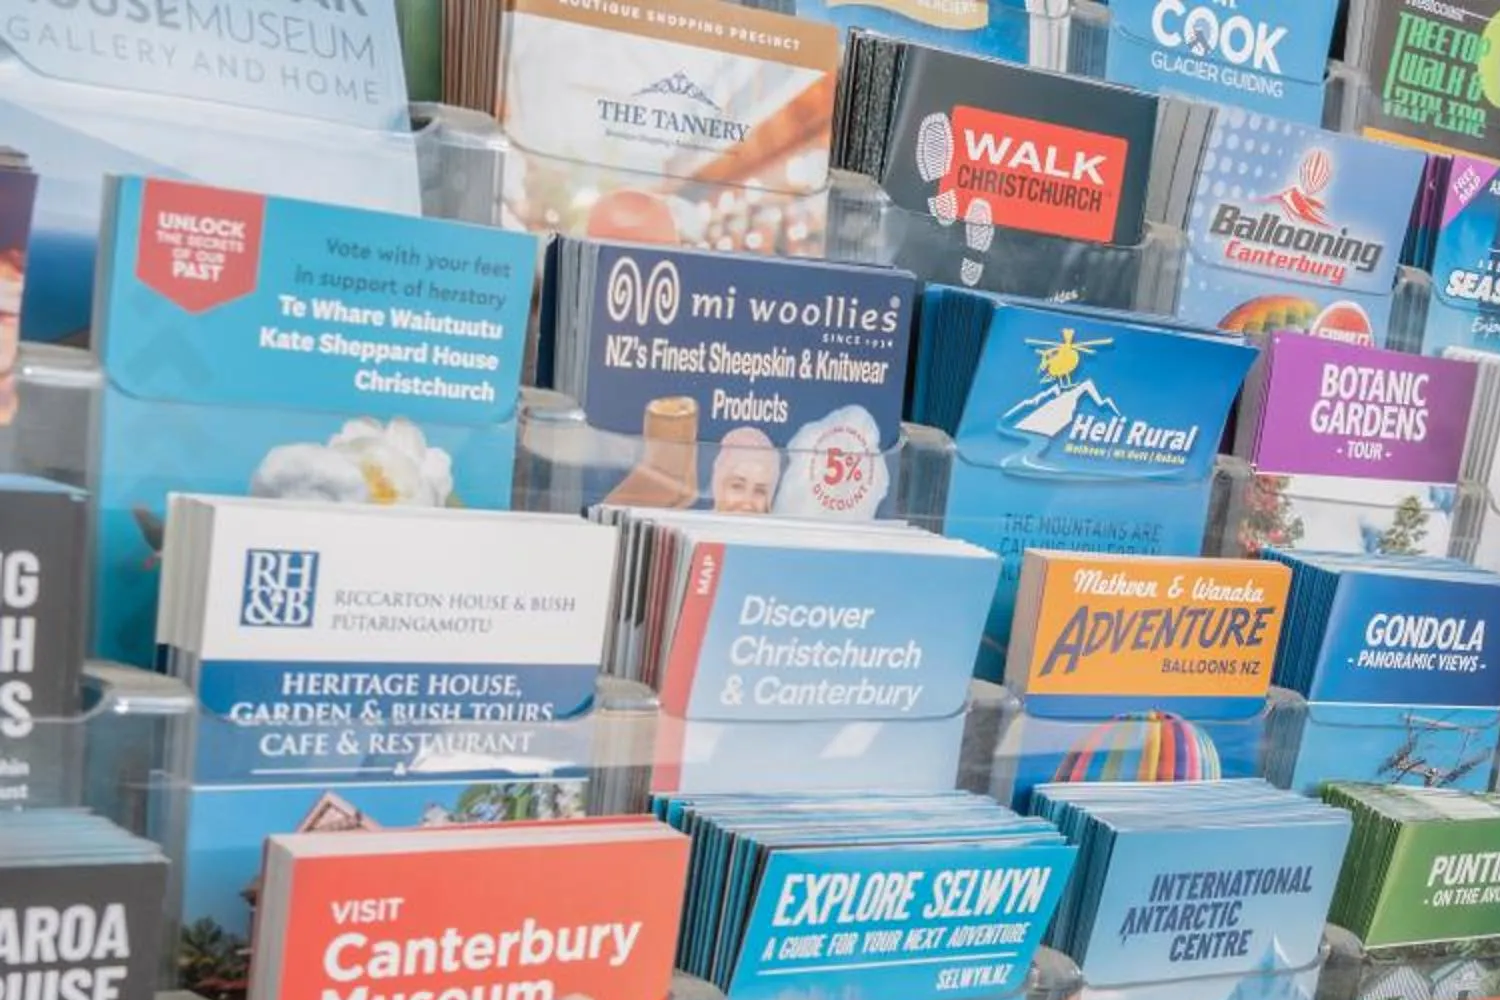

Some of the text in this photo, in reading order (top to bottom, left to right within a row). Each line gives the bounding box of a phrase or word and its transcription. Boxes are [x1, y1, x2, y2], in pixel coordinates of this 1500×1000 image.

[1152, 0, 1288, 74] COOK
[1152, 51, 1283, 97] GLACIER GUIDING
[597, 100, 646, 126] THE
[651, 109, 750, 143] TANNERY
[963, 127, 1107, 186] WALK
[956, 164, 1103, 212] CHRISTCHURCH
[158, 211, 246, 239] UNLOCK
[1210, 204, 1384, 274] Ballooning
[326, 237, 511, 279] Vote with your feet
[1224, 240, 1347, 285] Canterbury
[278, 295, 503, 341] Te Whare Waiutuutu
[692, 286, 898, 332] mi woollies
[259, 327, 499, 371] Kate Sheppard House
[605, 333, 889, 384] NZ's Finest Sheepskin & Knitwear
[354, 369, 496, 402] Christchurch
[1321, 364, 1430, 406] BOTANIC
[712, 388, 788, 422] Products
[1310, 400, 1429, 441] GARDENS
[1069, 414, 1198, 451] Heli Rural
[1346, 441, 1383, 461] TOUR
[334, 591, 576, 612] RICCARTON HOUSE & BUSH
[1073, 567, 1265, 603] Methven & Wanaka
[739, 596, 876, 629] Discover
[1040, 603, 1275, 677] ADVENTURE
[1365, 613, 1487, 652] GONDOLA
[729, 636, 923, 670] Christchurch
[1161, 656, 1261, 675] BALLOONS NZ
[1357, 648, 1479, 672] PANORAMIC VIEWS
[282, 673, 522, 698] HERITAGE HOUSE,
[720, 674, 923, 710] & Canterbury
[259, 730, 535, 756] CAFE & RESTAURANT
[772, 867, 1052, 927] EXPLORE SELWYN
[1148, 866, 1314, 903] INTERNATIONAL
[1433, 889, 1453, 907] ON
[1455, 887, 1480, 905] THE
[331, 897, 405, 925] VISIT
[1120, 902, 1243, 946] ANTARCTIC
[323, 918, 643, 982] Canterbury
[762, 922, 1031, 962] A GUIDE FOR YOUR NEXT ADVENTURE
[1169, 929, 1254, 963] CENTRE
